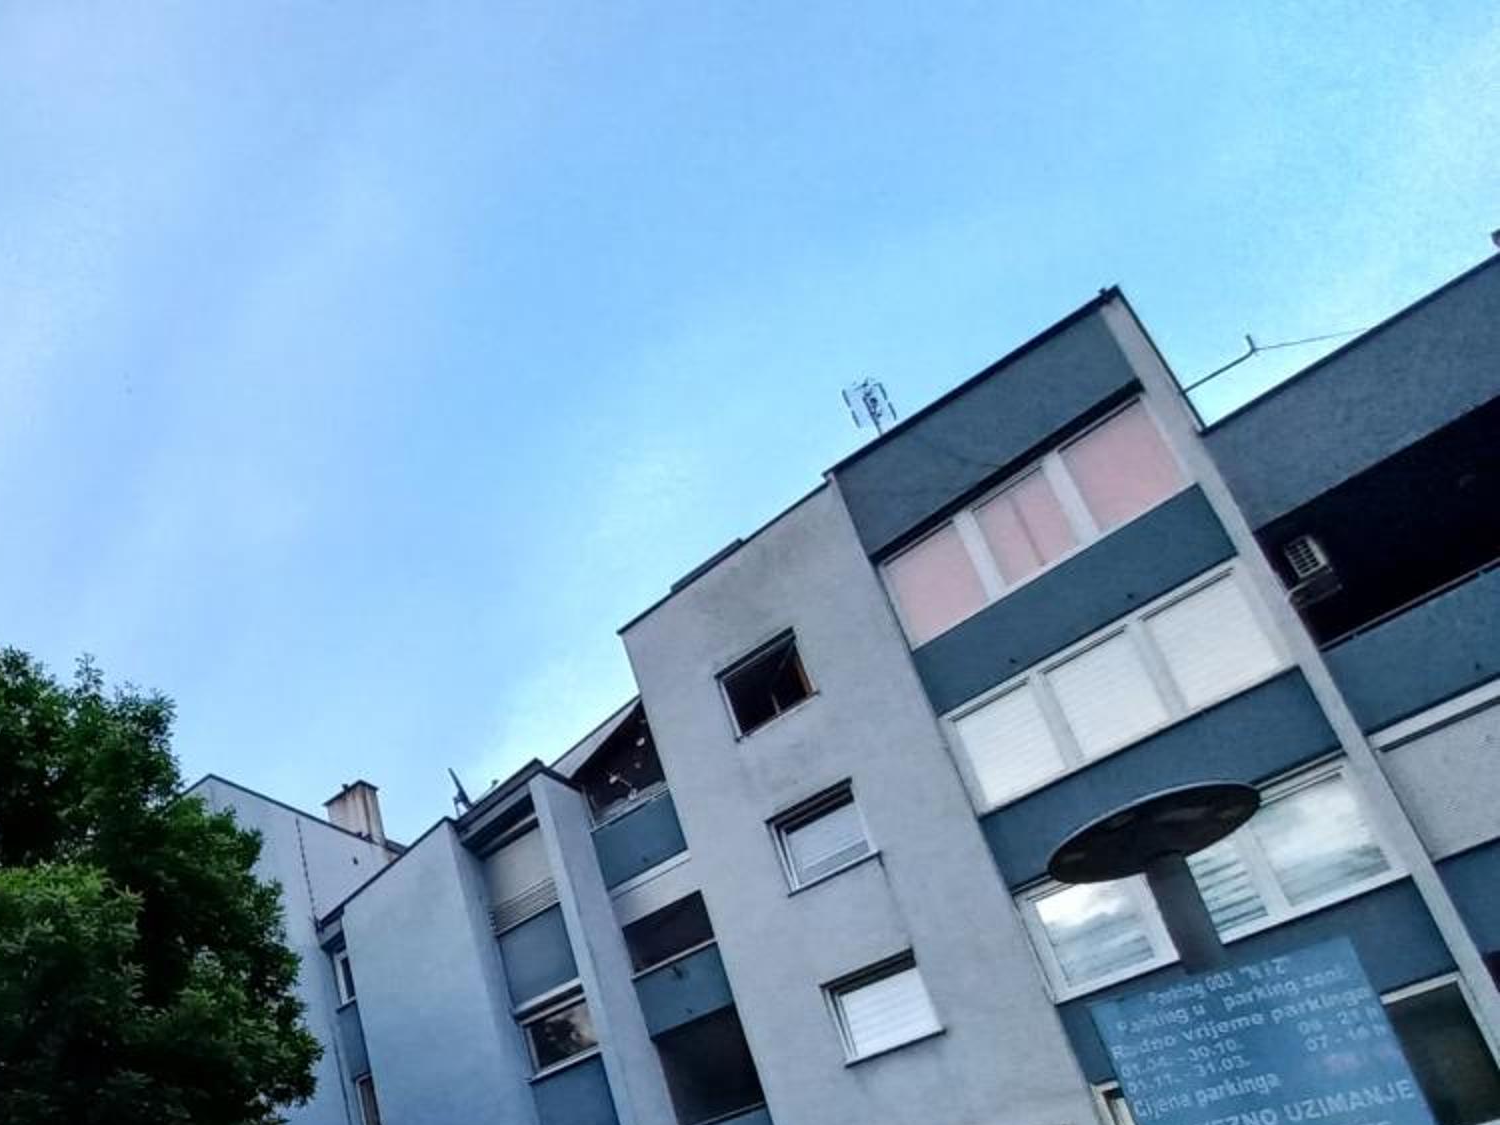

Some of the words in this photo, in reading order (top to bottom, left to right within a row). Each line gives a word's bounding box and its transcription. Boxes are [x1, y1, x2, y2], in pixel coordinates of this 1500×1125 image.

[1180, 1012, 1265, 1041] vrijeme
[1270, 986, 1373, 1024] parkinga
[1222, 980, 1300, 1012] parking
[1133, 1092, 1193, 1119] Cijena
[1195, 1073, 1281, 1107] parkinga
[1283, 1078, 1415, 1122] UZIMANJE
